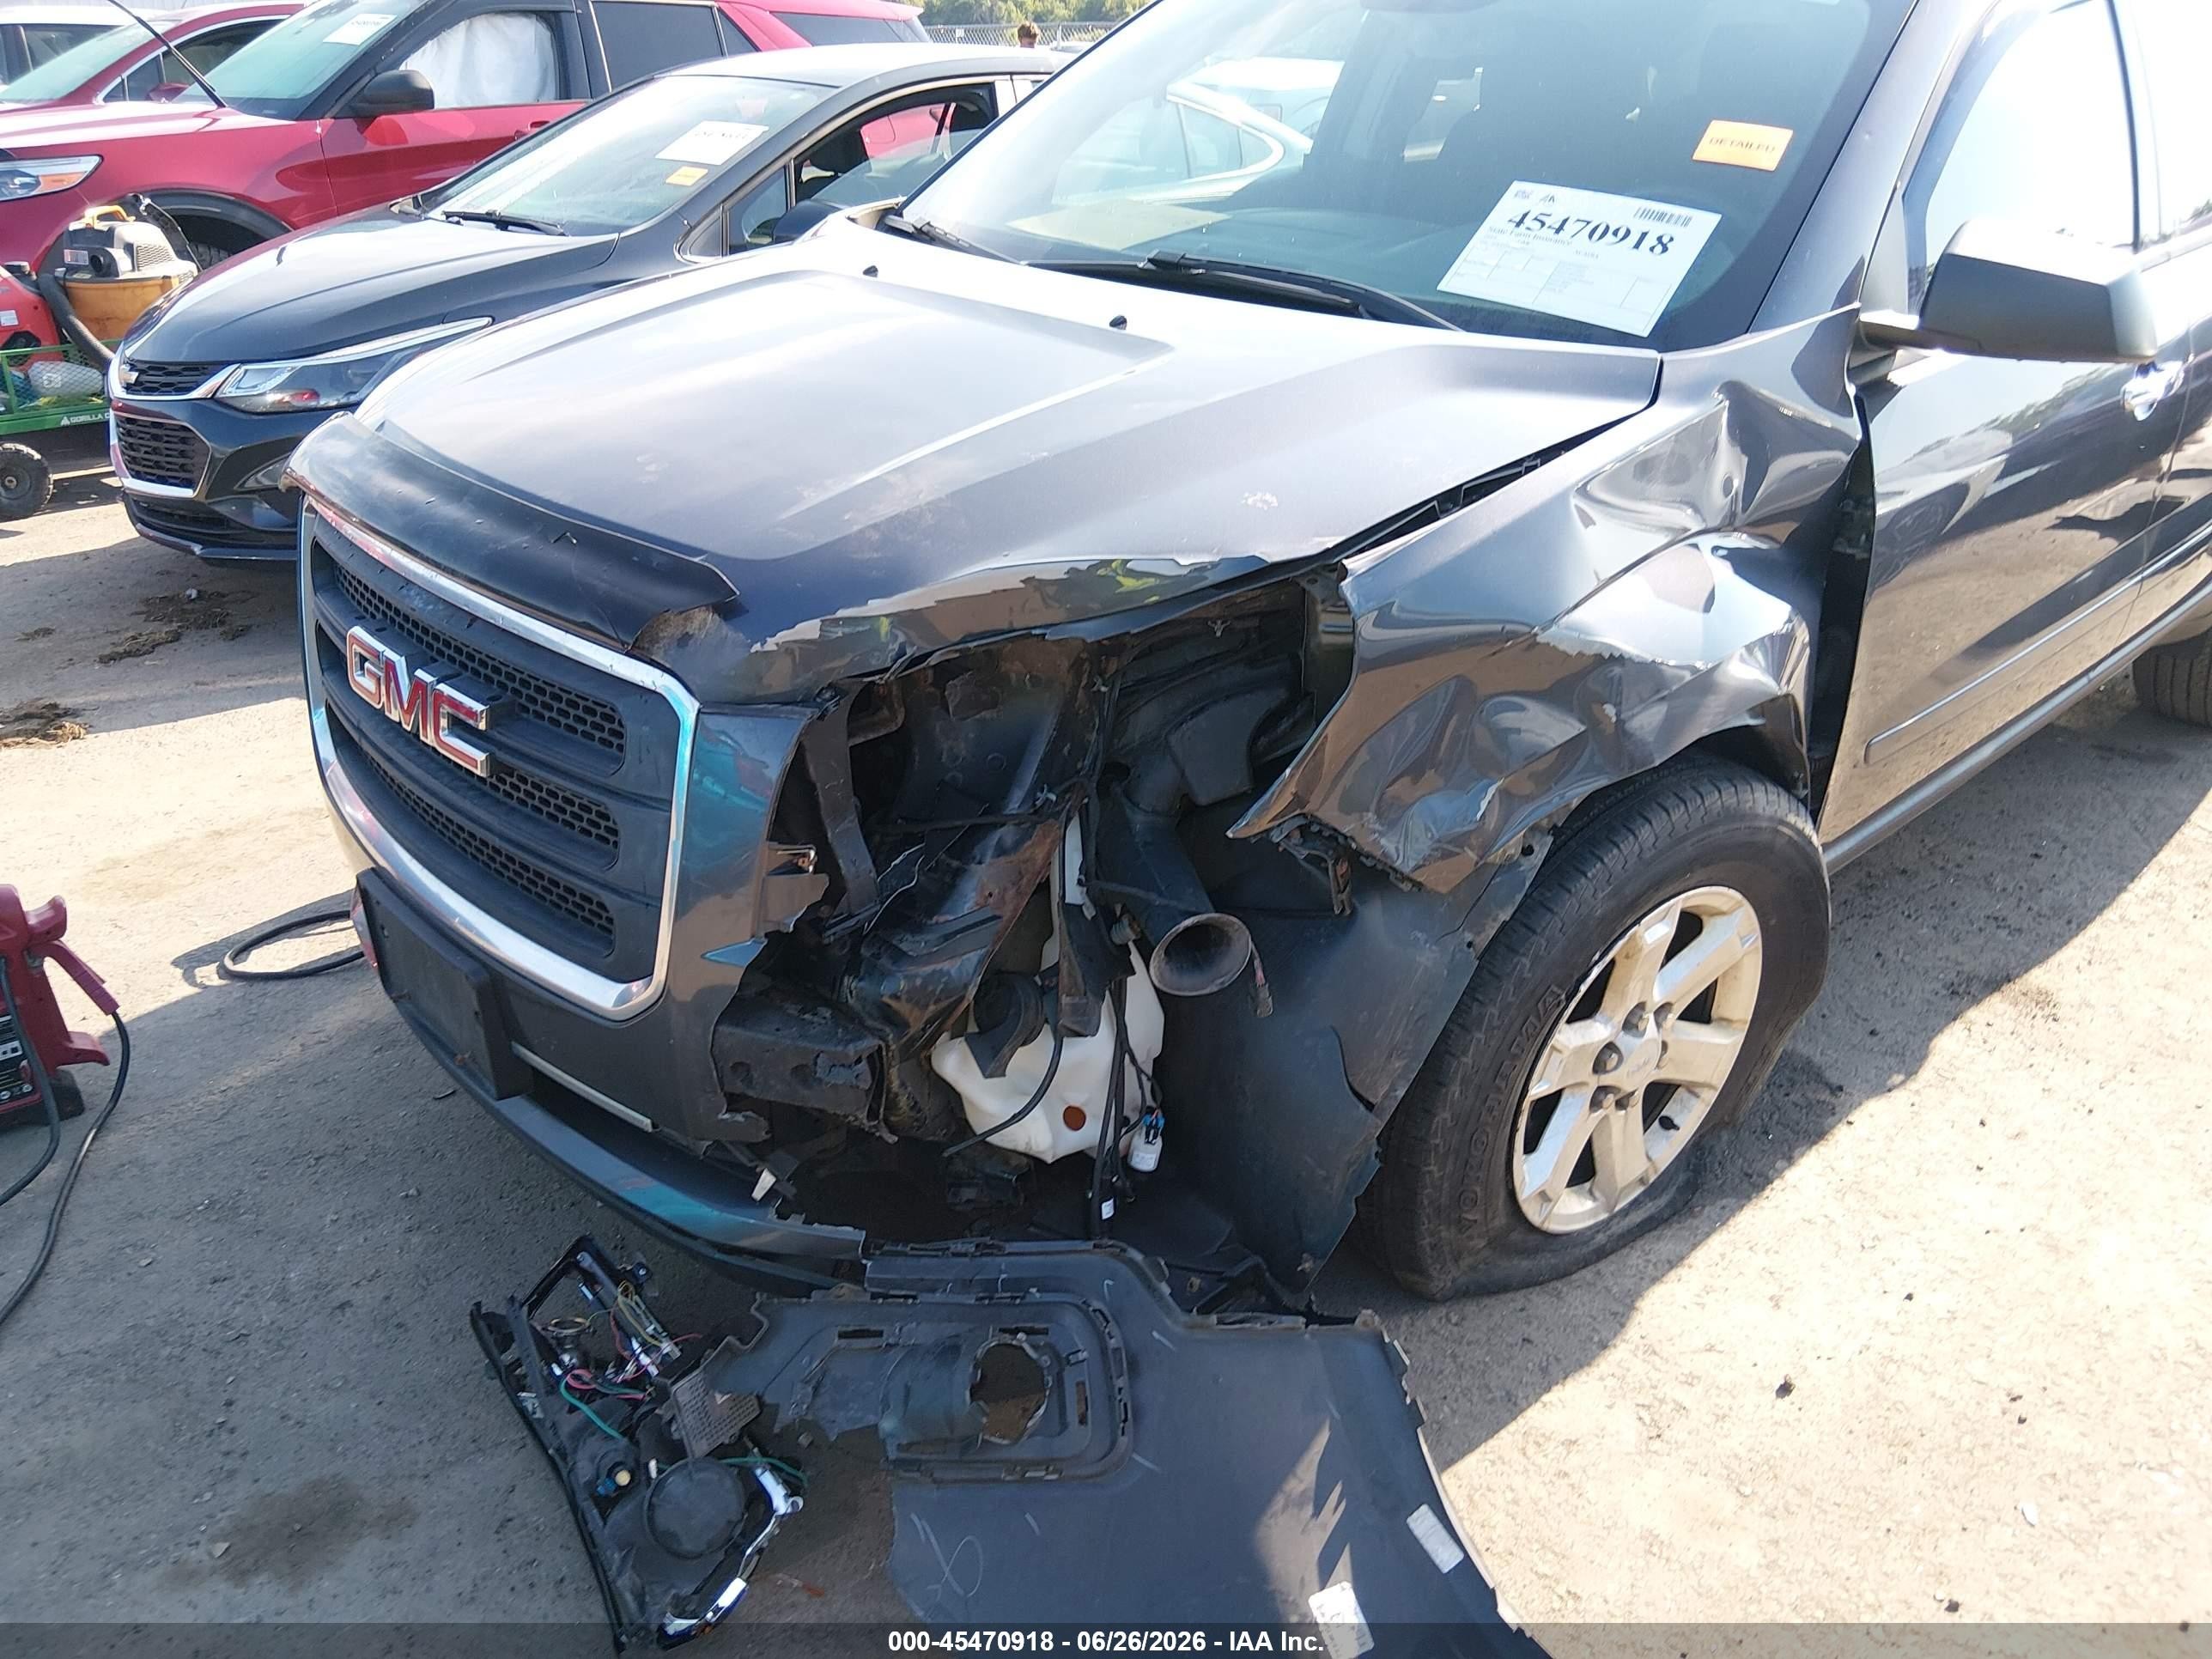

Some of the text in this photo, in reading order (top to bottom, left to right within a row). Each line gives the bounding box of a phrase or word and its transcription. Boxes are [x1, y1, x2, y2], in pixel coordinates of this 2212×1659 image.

[1709, 137, 1776, 153] DETAILED
[1507, 209, 1674, 256] 45470918
[70, 413, 104, 423] GORILLA
[347, 625, 491, 778] GMC
